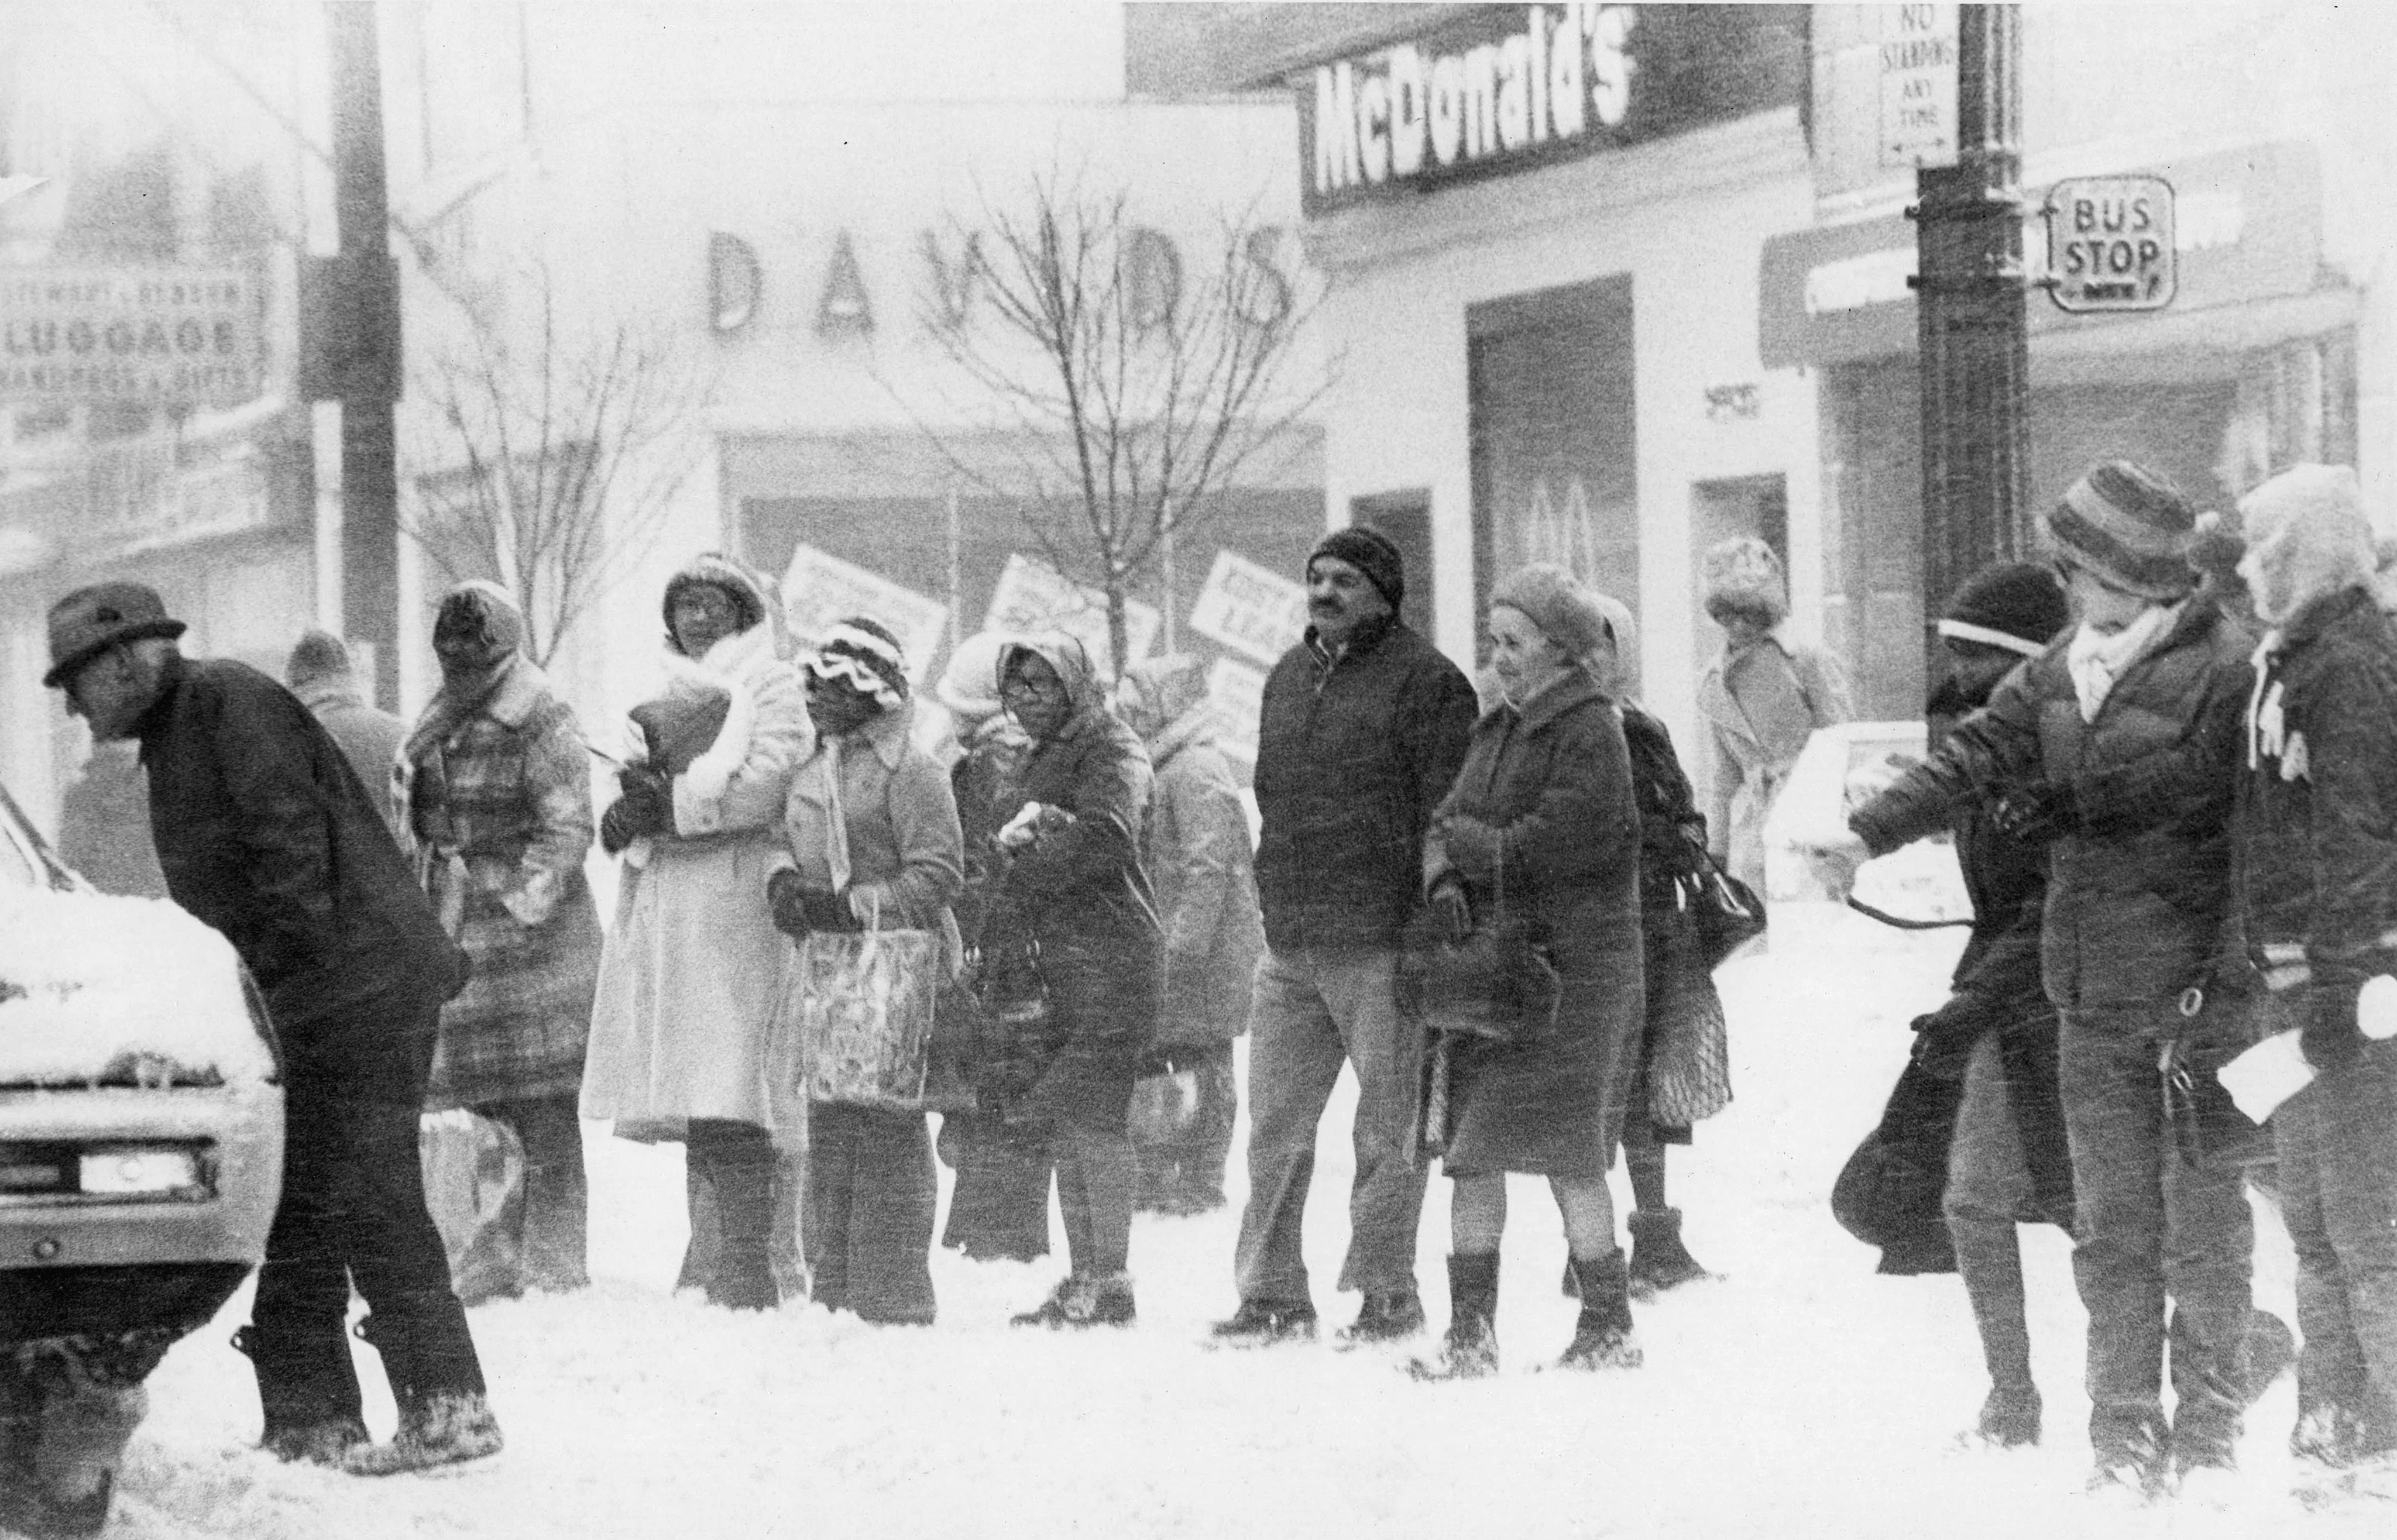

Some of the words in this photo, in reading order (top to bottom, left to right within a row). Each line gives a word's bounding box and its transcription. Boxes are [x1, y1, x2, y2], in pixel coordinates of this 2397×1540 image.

[1315, 4, 1637, 194] McDonald's
[2076, 198, 2149, 232] BUS
[2066, 240, 2160, 275] STOP
[706, 225, 1292, 331] DAVDS
[5, 319, 234, 355] LUGGAGE
